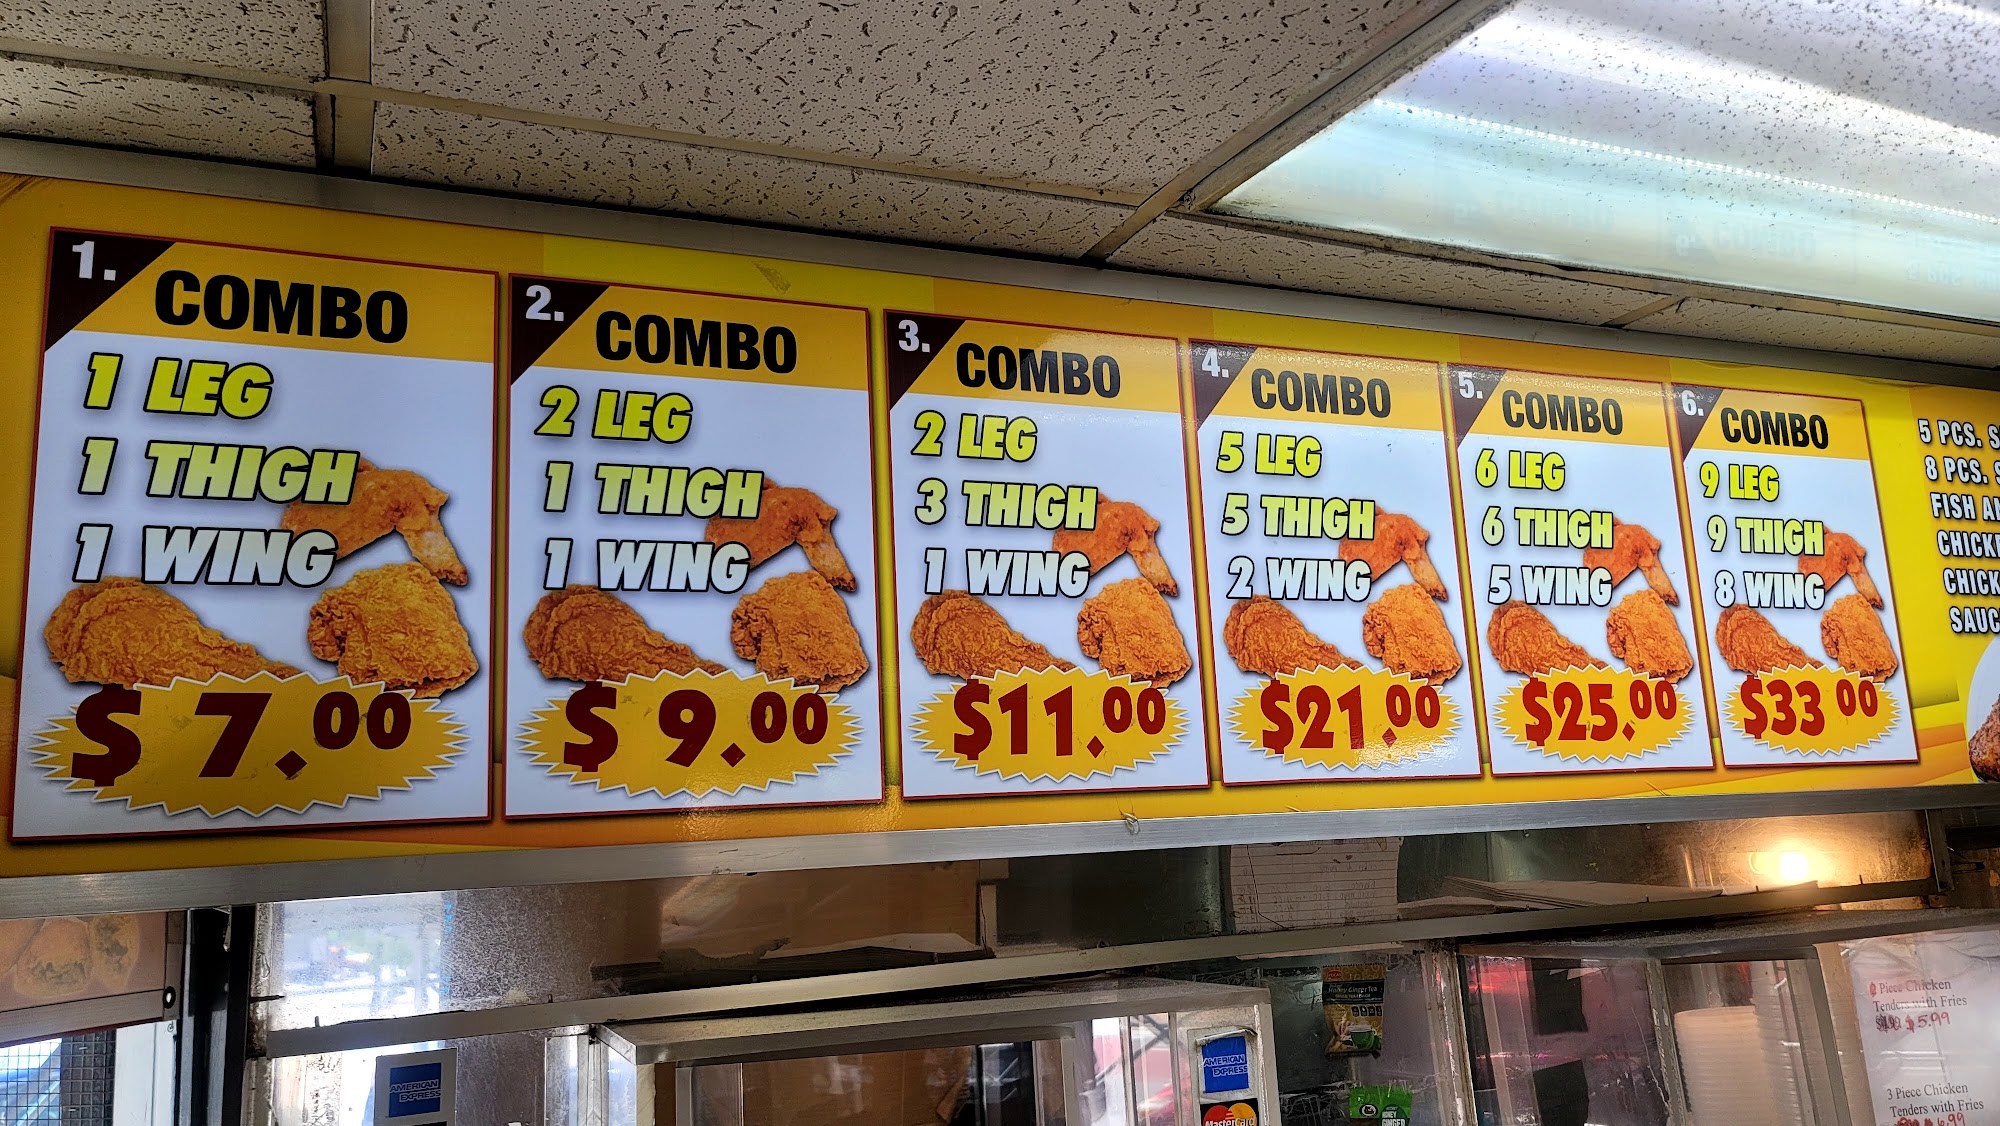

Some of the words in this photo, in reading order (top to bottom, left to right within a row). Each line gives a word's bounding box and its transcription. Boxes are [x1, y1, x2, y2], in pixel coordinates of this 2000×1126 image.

[72, 240, 117, 281] 1.
[155, 270, 408, 343] COMBO
[525, 285, 565, 322] 2.
[595, 310, 797, 374] COMBO
[898, 319, 931, 353] 3.
[956, 342, 1121, 399] COMBO
[1201, 348, 1230, 378] 4.
[84, 352, 123, 410] 1
[143, 356, 274, 420] LEG
[1251, 367, 1392, 419] COMBO
[1458, 371, 1483, 400] 5.
[1681, 389, 1704, 417] 6.
[533, 385, 580, 437] 2
[591, 388, 693, 444] LEG
[1502, 389, 1624, 435] COMBO
[1720, 407, 1829, 450] COMBO
[1918, 418, 1932, 444] 5
[1937, 420, 1983, 448] PCS.
[911, 409, 947, 457] 2
[957, 413, 1038, 463] LEG
[1216, 430, 1245, 473] 5
[1255, 433, 1323, 478] LEG
[78, 436, 119, 495] 1
[145, 439, 361, 505] THIGH
[544, 461, 574, 512] 1
[595, 463, 765, 519] THIGH
[1475, 448, 1499, 488] 6
[1508, 450, 1566, 492] LEG
[1699, 461, 1720, 498] 9
[1728, 463, 1780, 503] LEG
[1924, 455, 1939, 481] 8
[1943, 456, 1989, 484] PCS.
[914, 477, 948, 526] 3
[961, 480, 1099, 531] THIGH
[1221, 492, 1250, 536] 5
[1260, 494, 1376, 541] THIGH
[1930, 492, 1977, 520] FISH
[1482, 506, 1505, 547] 6
[1514, 507, 1614, 550] THIGH
[1706, 514, 1727, 552] 9
[1735, 516, 1825, 557] THIGH
[72, 523, 113, 583] 1
[141, 526, 338, 588] WING
[543, 537, 573, 590] 1
[597, 538, 752, 594] WING
[924, 547, 947, 597] 1
[965, 549, 1092, 598] WING
[1226, 555, 1255, 600] 2
[1266, 557, 1373, 603] WING
[1488, 564, 1512, 605] 5
[1521, 565, 1613, 607] WING
[1714, 569, 1736, 609] 8
[1743, 570, 1825, 611] WING
[953, 678, 1167, 761] $11.00
[1260, 679, 1441, 755] $21.00
[1522, 677, 1677, 747] $25.00
[1348, 985, 1367, 995] Ginger
[1368, 985, 1378, 993] Tea
[1873, 999, 1910, 1012] Tenders
[1940, 995, 1967, 1007] Fries
[1879, 982, 1902, 994] Piece
[1906, 979, 1951, 992] Chicken
[1203, 1054, 1245, 1067] AMERICAN
[1212, 1064, 1248, 1077] EXPRESS
[389, 1079, 440, 1093] AMERICAN
[399, 1090, 441, 1103] EXPRESS
[1887, 1088, 1893, 1100] 3
[1895, 1087, 1921, 1099] Piece
[1924, 1083, 1968, 1096] Chicken
[1890, 1104, 1929, 1118] Tenders
[1931, 1101, 1955, 1113] with
[1957, 1099, 1984, 1112] Fries
